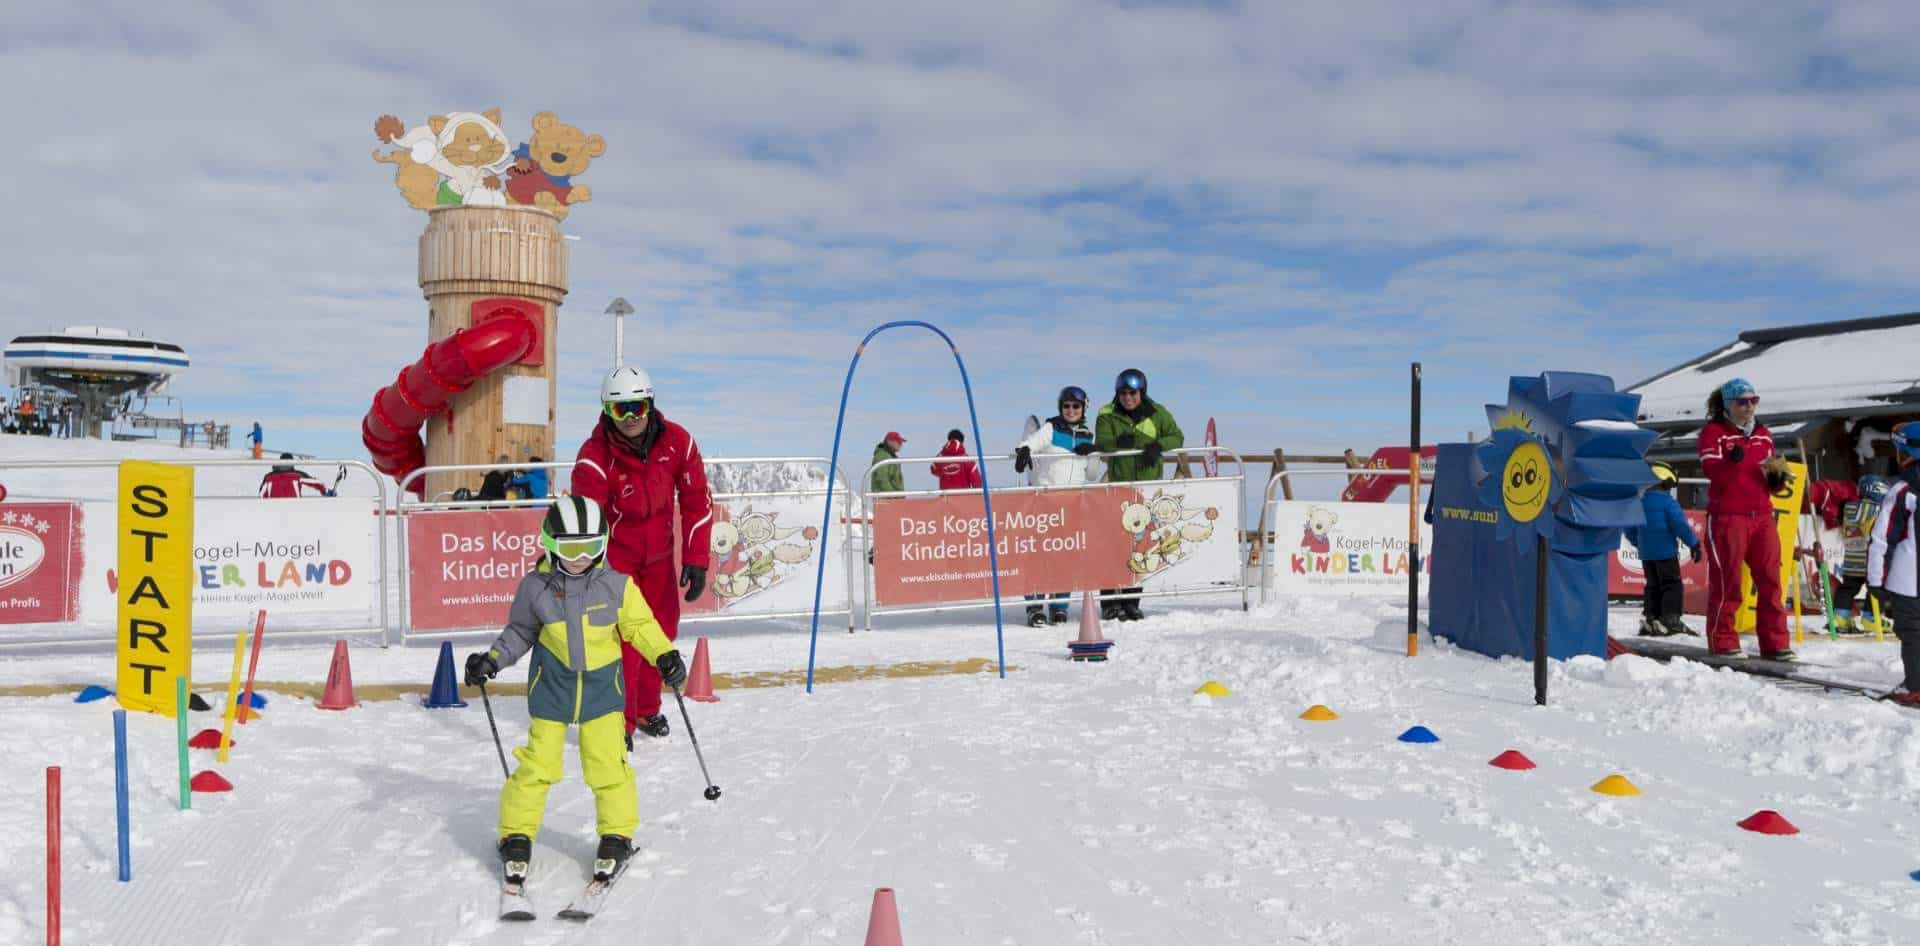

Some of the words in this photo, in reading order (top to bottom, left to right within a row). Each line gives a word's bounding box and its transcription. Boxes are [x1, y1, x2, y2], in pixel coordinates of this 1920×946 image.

[900, 516, 937, 537] Das
[943, 507, 1065, 538] Kogel-Mogel
[193, 539, 322, 562] ogel-Mogel
[441, 532, 485, 553] Das
[1014, 535, 1037, 554] ist
[1042, 531, 1087, 552] cool!
[1336, 535, 1423, 552] Kogel-Mogl
[258, 559, 352, 588] LAND
[127, 484, 171, 695] START
[10, 598, 41, 609] Profis
